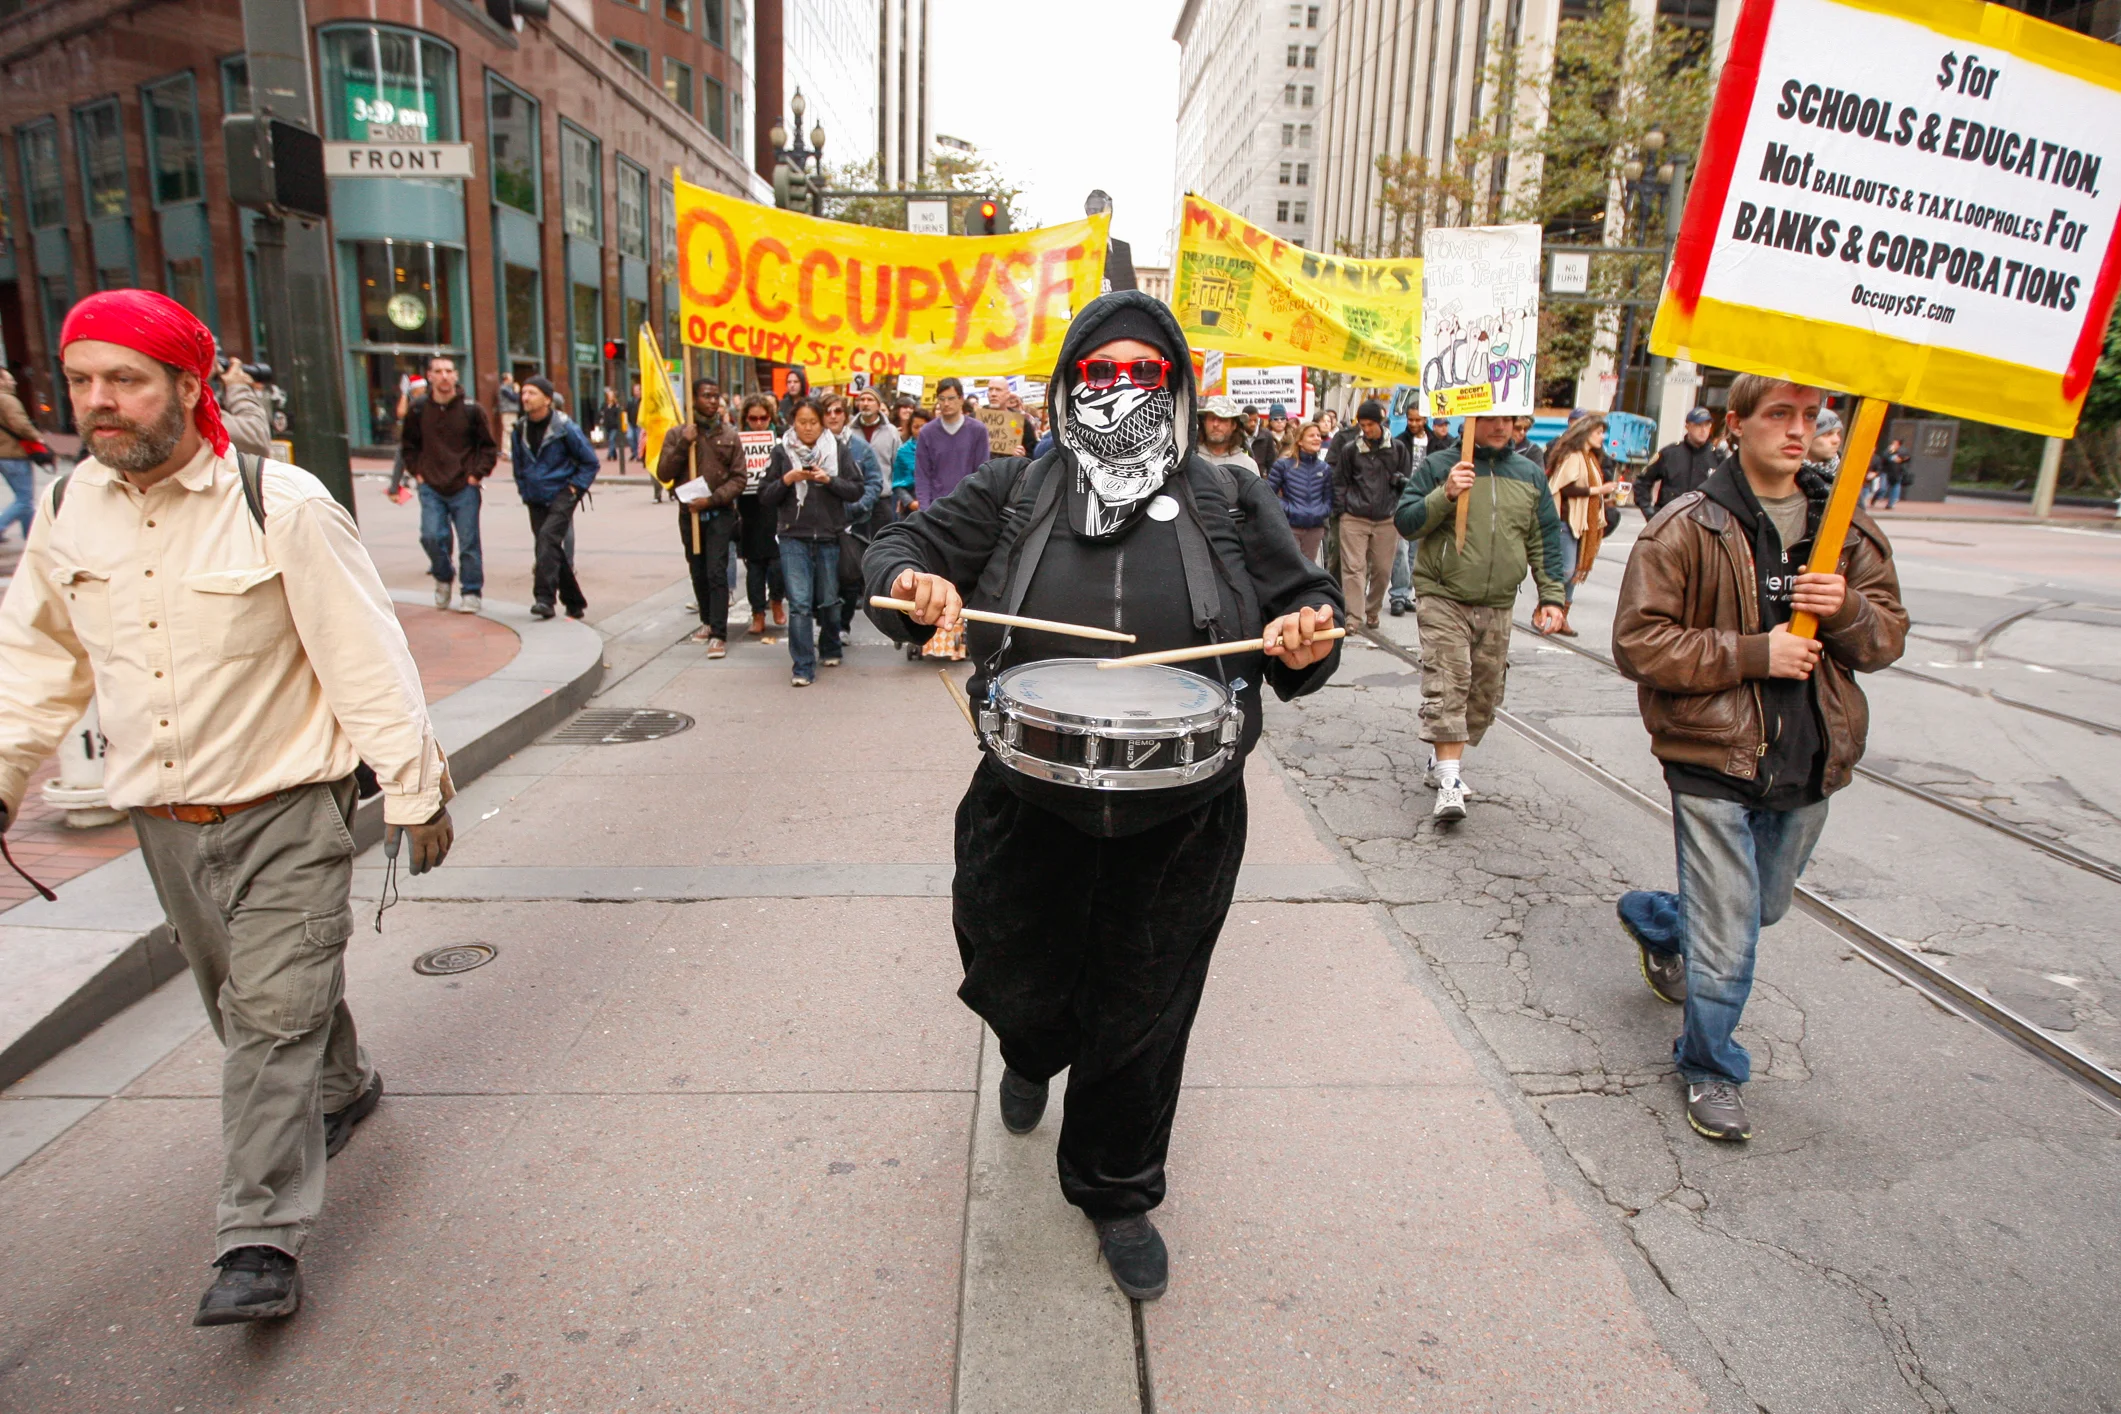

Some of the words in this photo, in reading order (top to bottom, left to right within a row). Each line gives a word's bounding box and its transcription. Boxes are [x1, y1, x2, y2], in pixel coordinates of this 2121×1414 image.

[1937, 51, 1957, 90] $
[1958, 55, 1999, 100] for
[1777, 79, 1918, 146] SCHOOLS
[1917, 113, 1943, 153] &
[1942, 118, 2102, 198] EDUCATION,
[349, 150, 442, 169] FRONT
[1759, 142, 1814, 189] Not
[1812, 169, 1900, 210] BAILOUTS
[1900, 190, 1914, 211] &
[2045, 209, 2089, 253] For
[921, 212, 936, 222] NO
[912, 224, 945, 233] TURNS
[1500, 233, 1521, 259] 2
[1733, 201, 1840, 259] BANKS
[1840, 225, 1864, 264] &
[1866, 230, 2080, 312] CORPORATIONS
[1565, 264, 1577, 273] NO
[1557, 274, 1584, 284] TURNS
[1851, 284, 1955, 324] OccupySF.com
[1460, 386, 1484, 395] OCCUPY
[981, 413, 1005, 426] WHO
